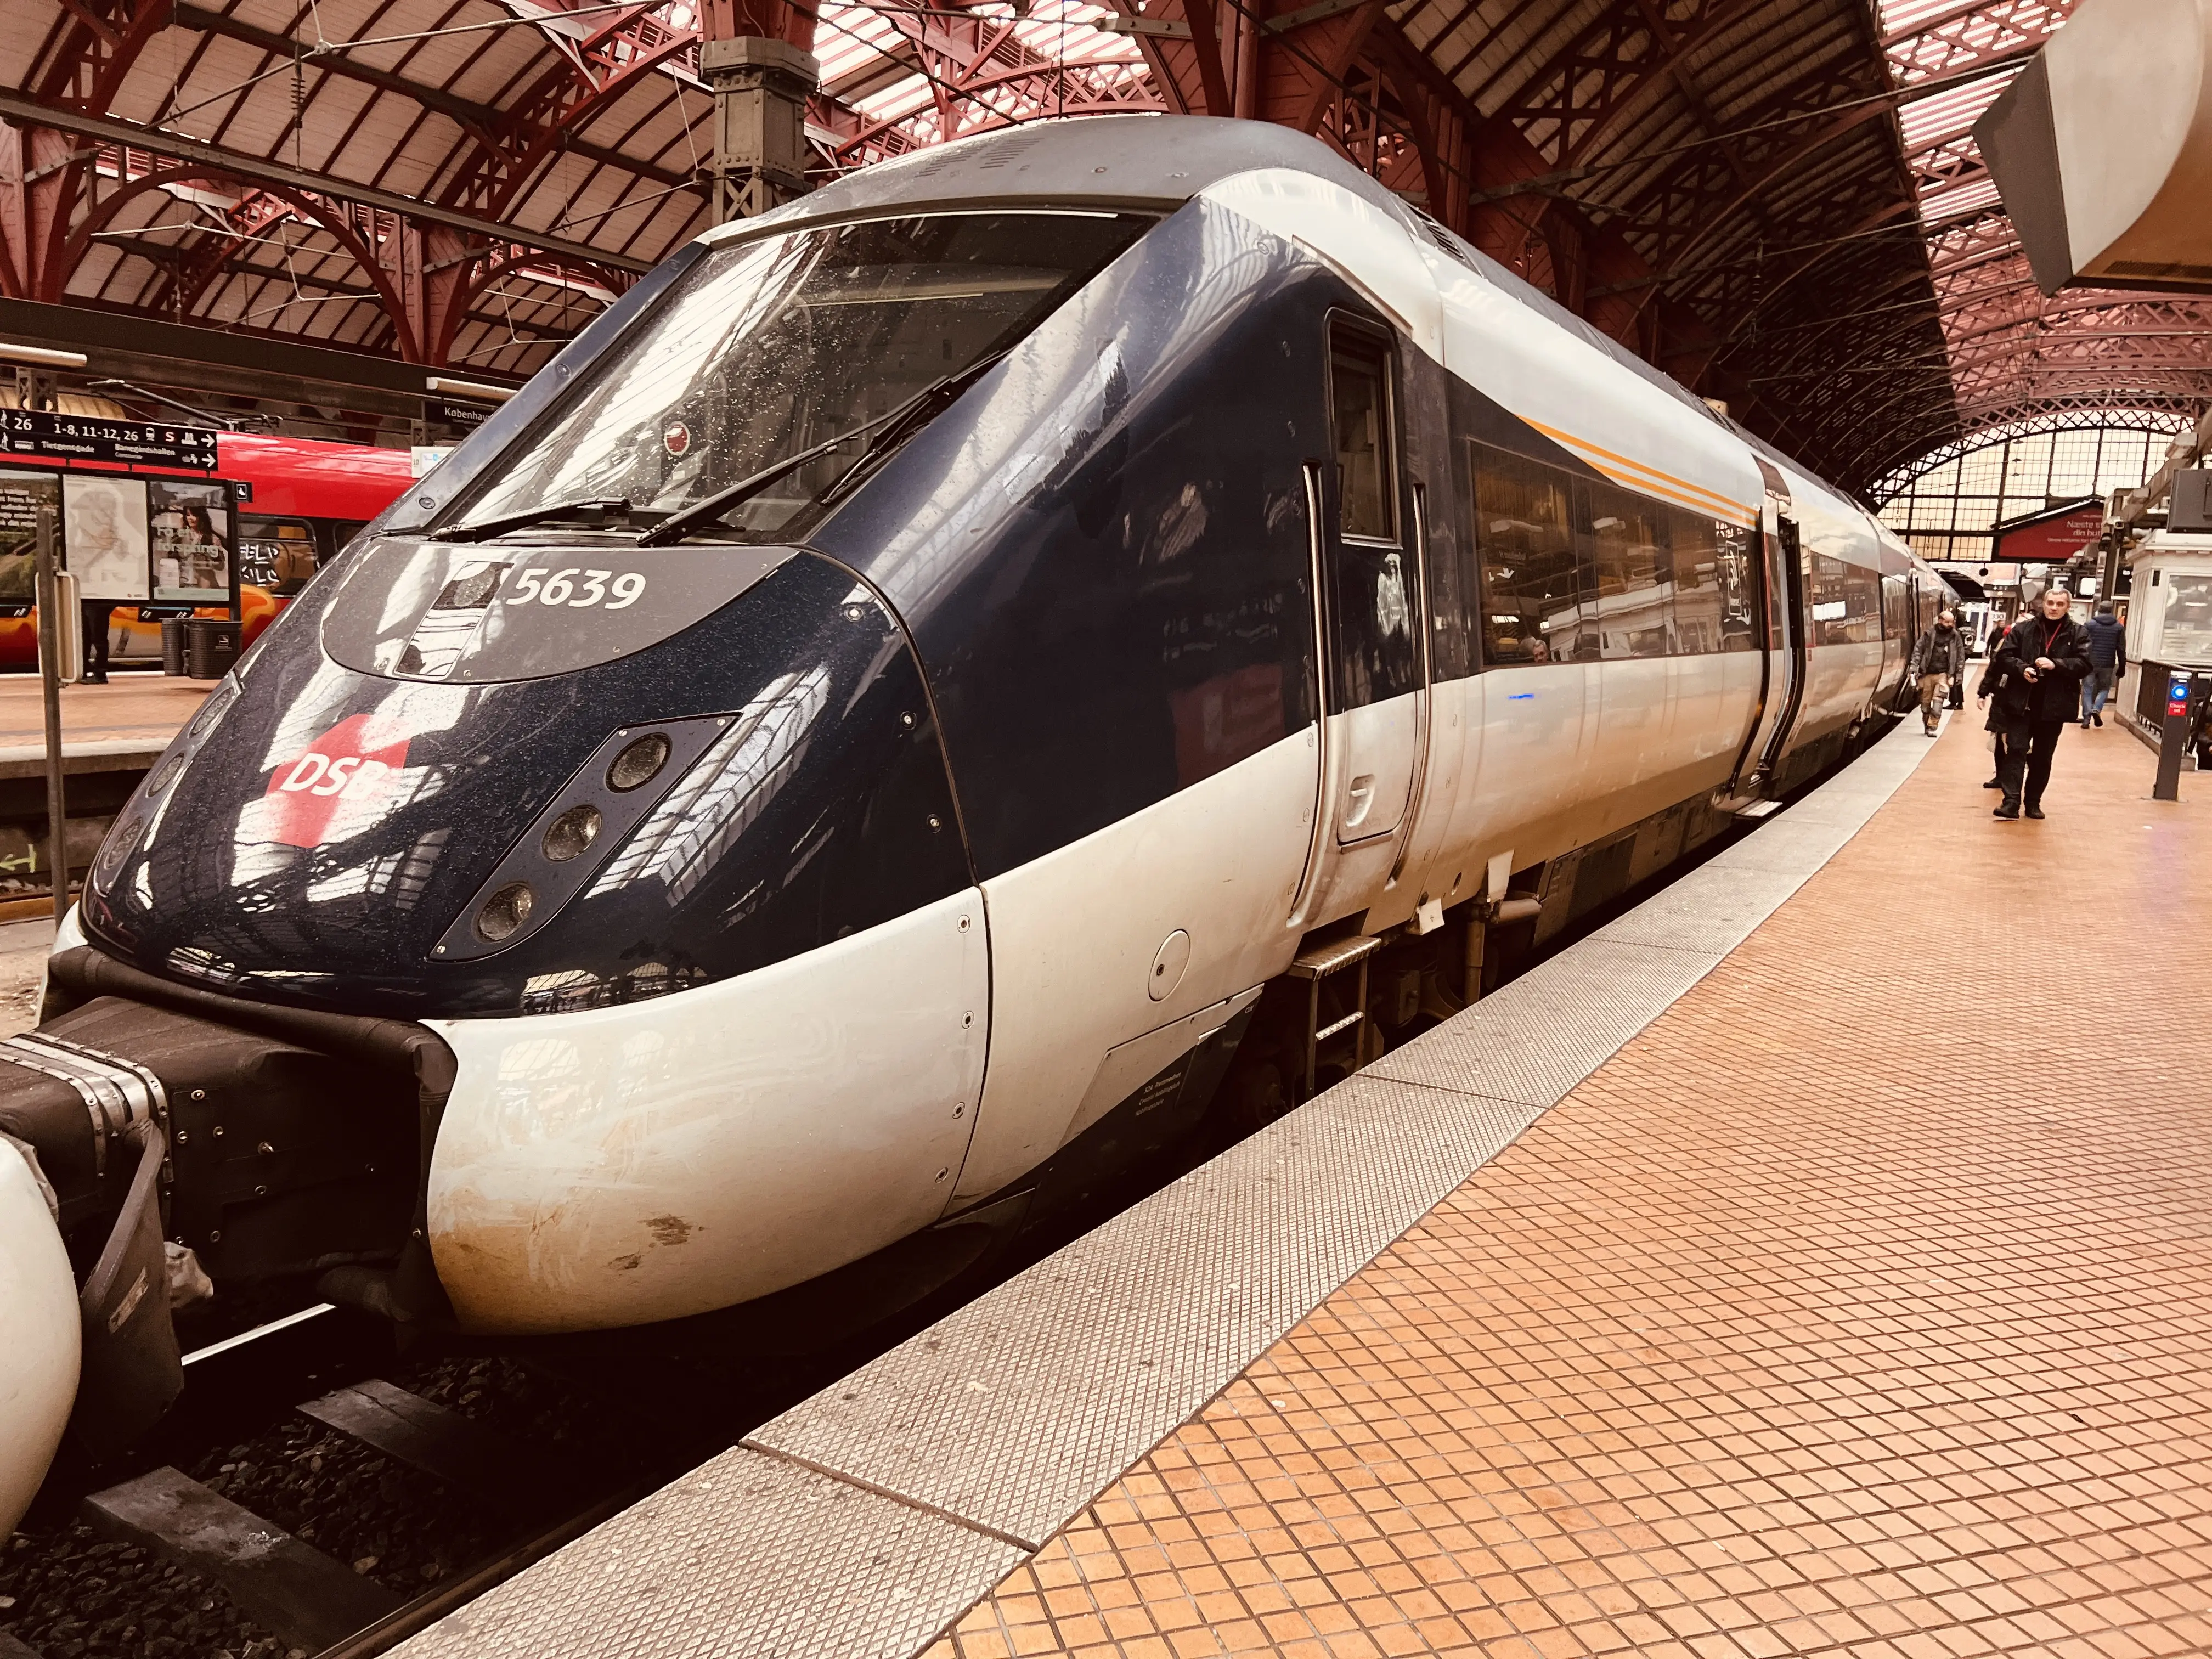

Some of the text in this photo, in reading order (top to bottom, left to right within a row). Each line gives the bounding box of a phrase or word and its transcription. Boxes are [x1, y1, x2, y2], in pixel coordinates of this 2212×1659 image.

[14, 417, 32, 431] 26
[54, 423, 175, 442] 1-8, 11-12, 26 S
[505, 568, 646, 609] 5639
[1995, 600, 2004, 611] F
[279, 752, 388, 799] DSB
